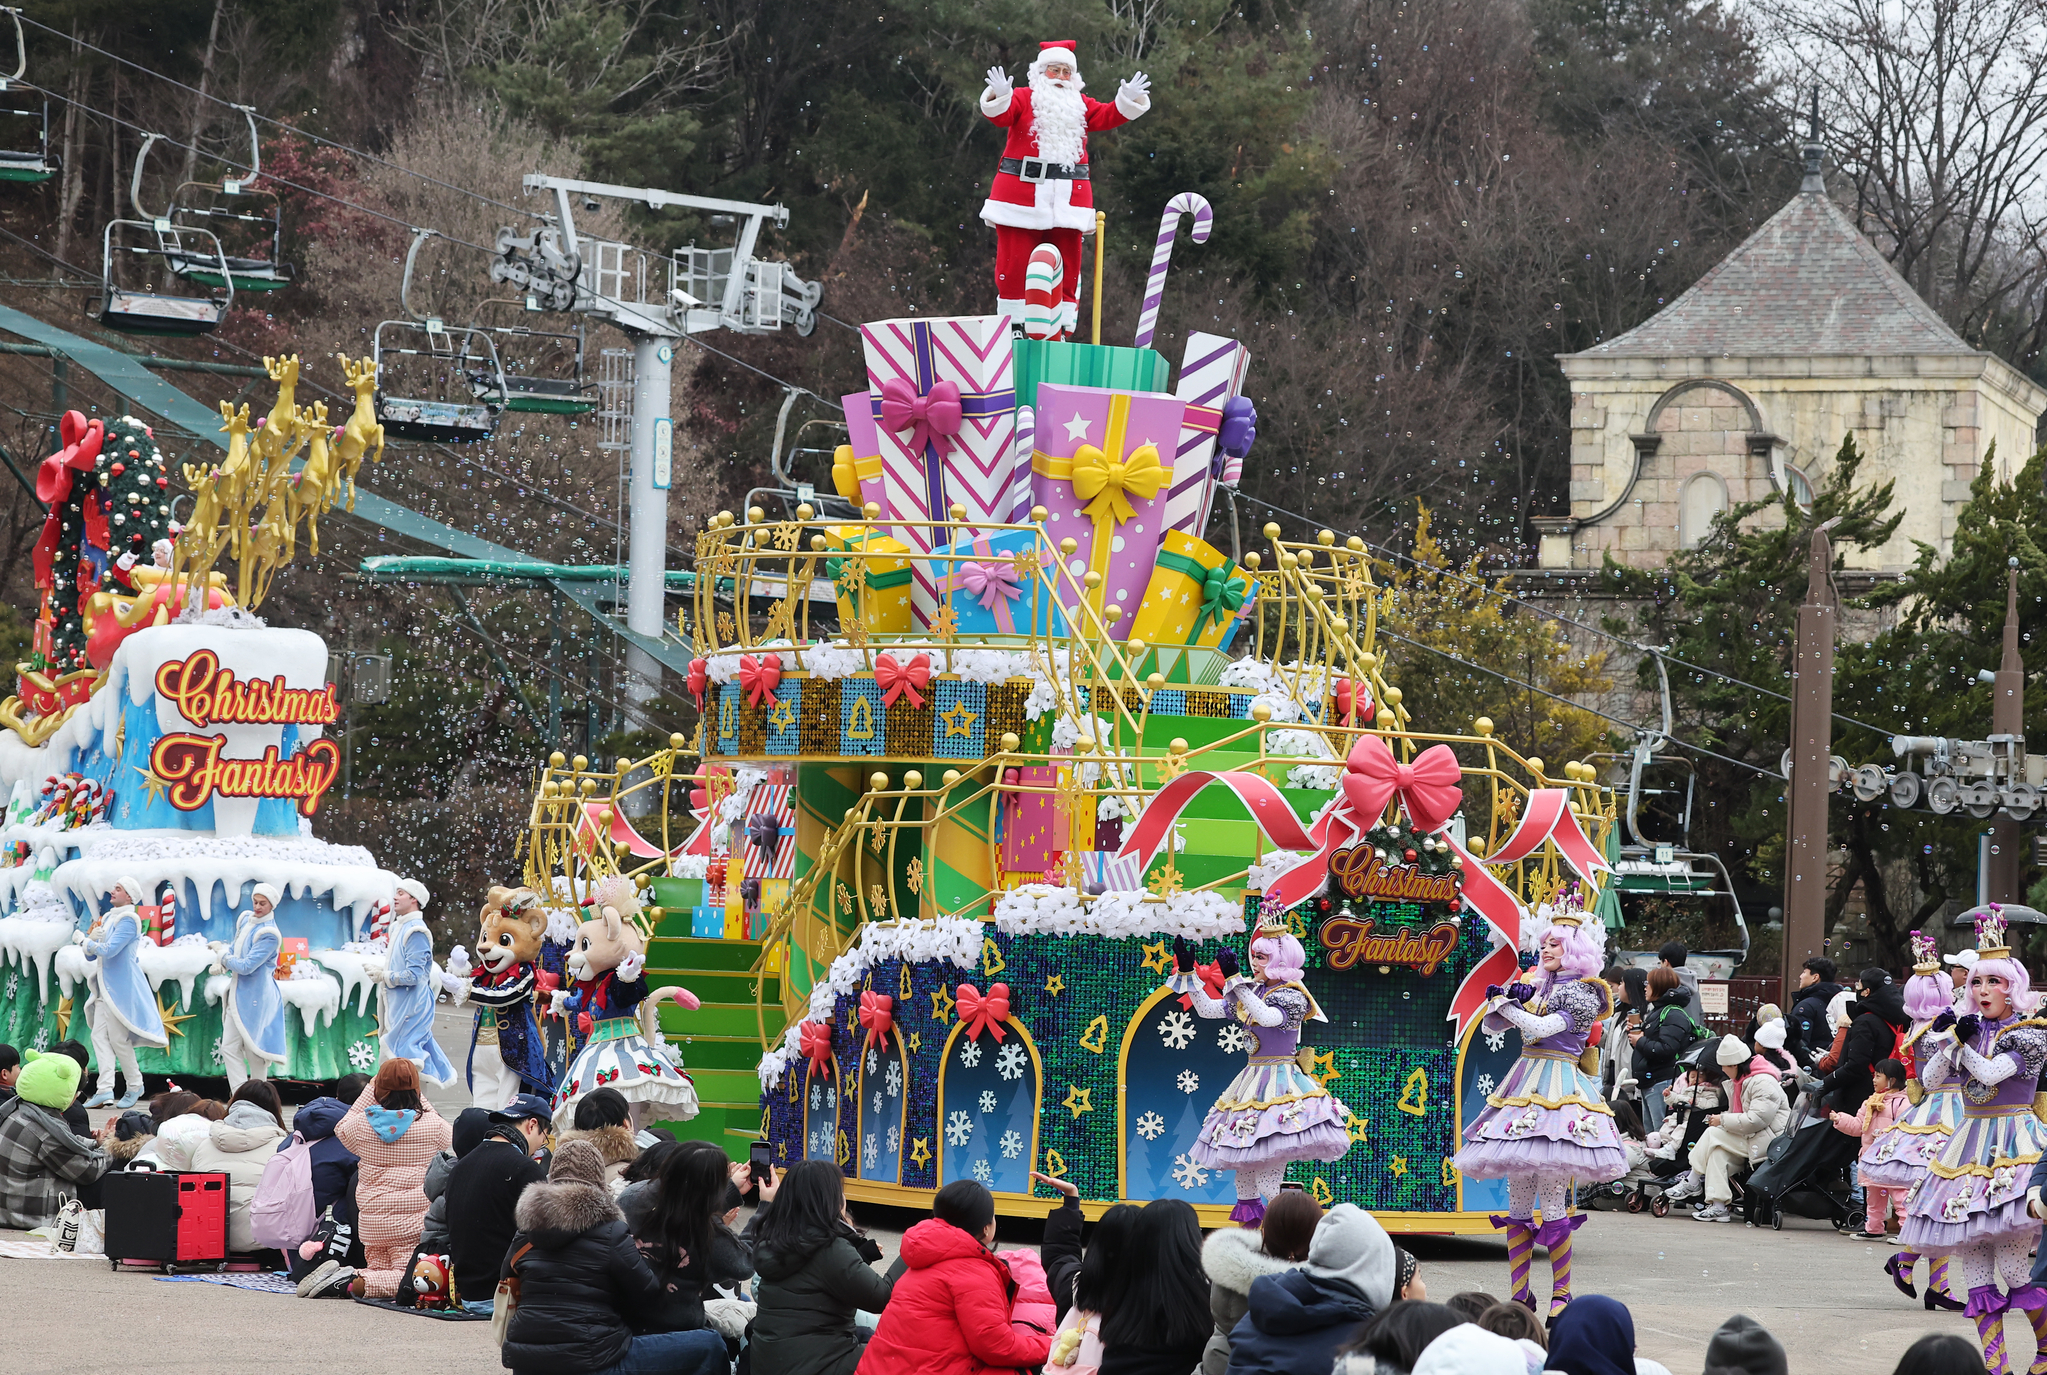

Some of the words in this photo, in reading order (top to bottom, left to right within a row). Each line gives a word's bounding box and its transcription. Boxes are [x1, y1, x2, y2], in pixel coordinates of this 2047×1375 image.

[155, 650, 339, 726] Christmas
[152, 733, 340, 815] Fantasy
[1329, 843, 1461, 900] Christmas
[1319, 916, 1460, 977] Fantasy
